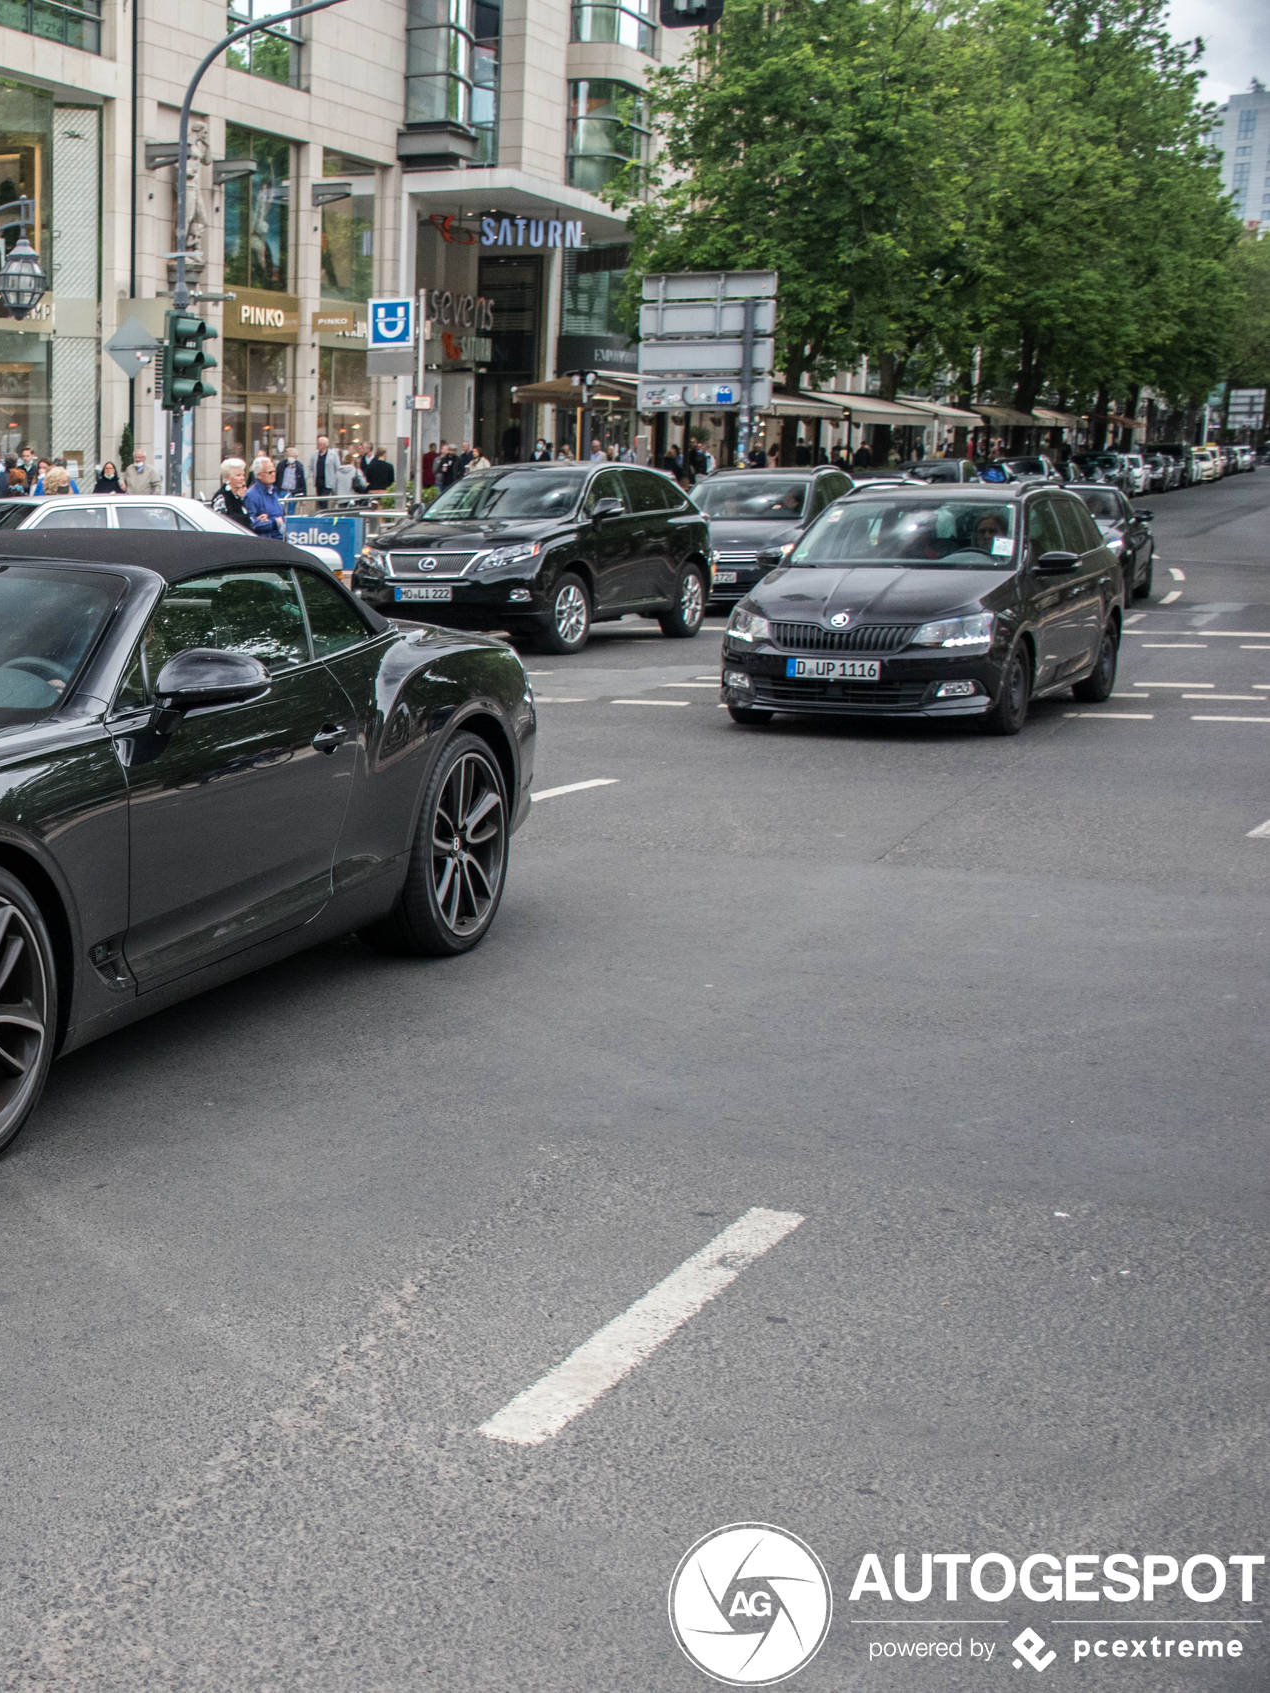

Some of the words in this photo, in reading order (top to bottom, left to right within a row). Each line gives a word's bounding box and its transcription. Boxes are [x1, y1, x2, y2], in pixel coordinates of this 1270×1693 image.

[481, 218, 582, 248] SATURN
[241, 305, 285, 327] PINKO
[430, 291, 495, 331] sevens
[318, 317, 348, 326] PINKO
[287, 528, 341, 545] sallee
[400, 588, 413, 599] MO
[432, 588, 450, 599] 222
[796, 661, 806, 675] D
[816, 661, 836, 676] UP
[839, 662, 877, 677] 1116
